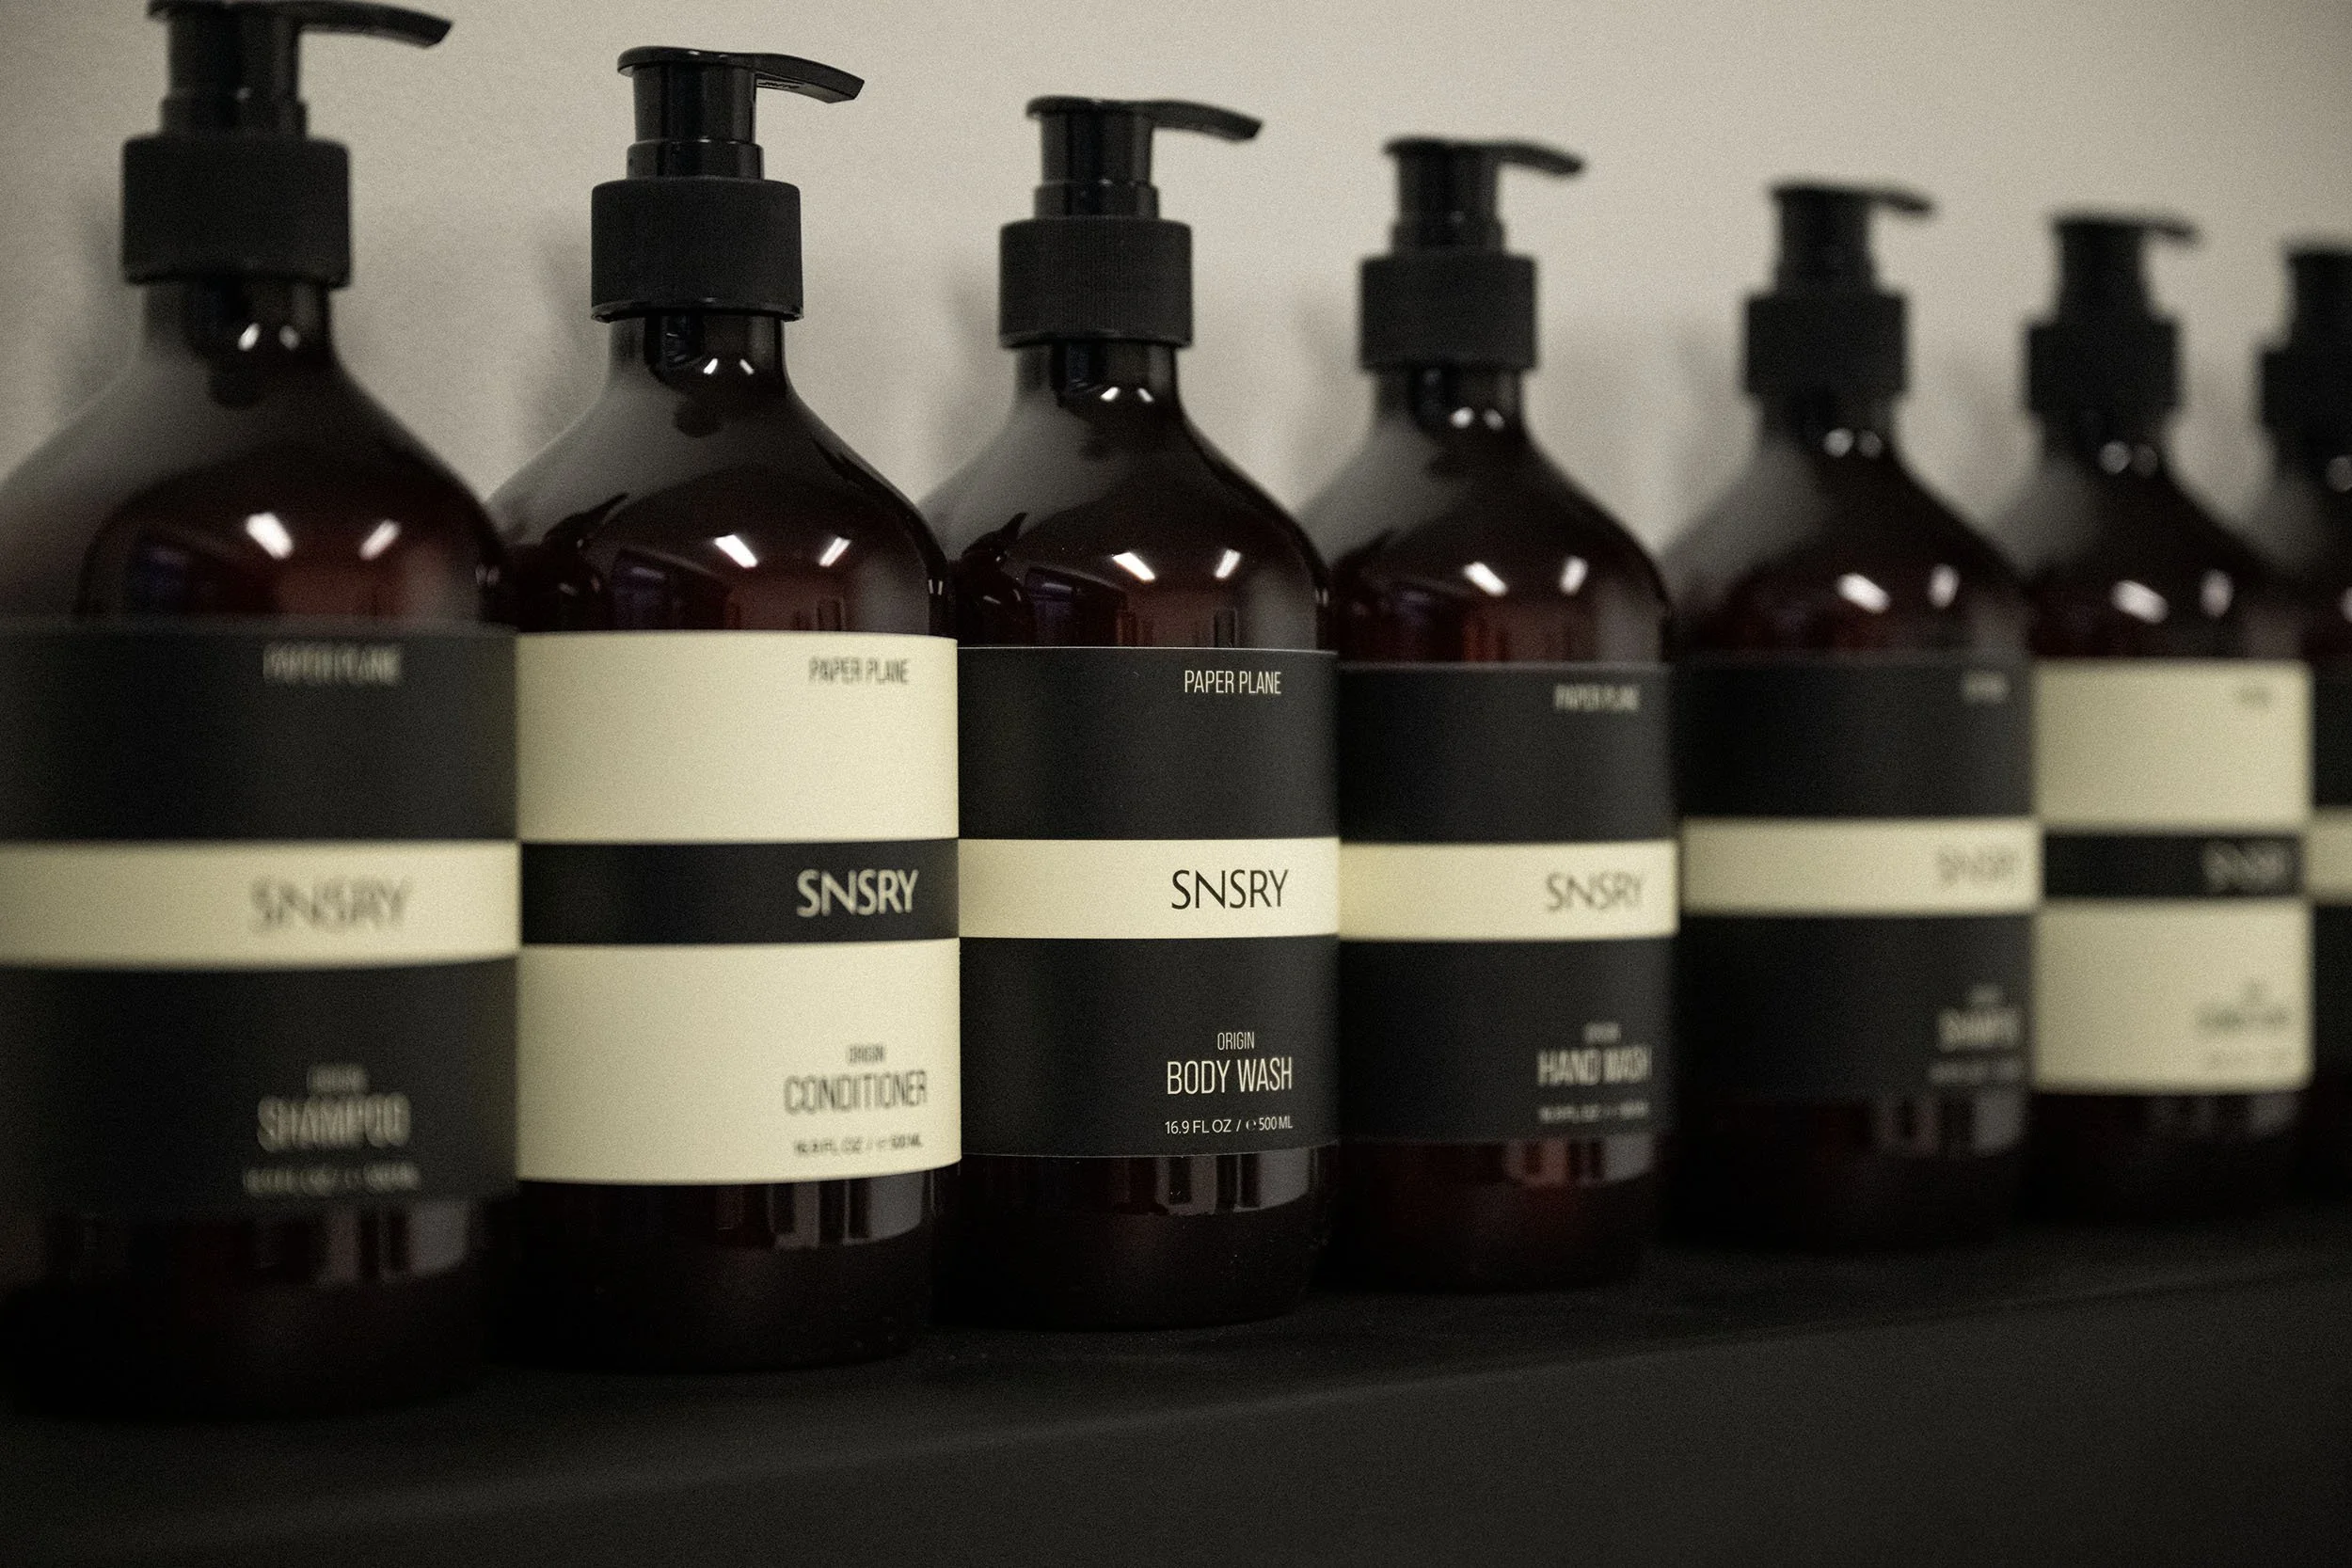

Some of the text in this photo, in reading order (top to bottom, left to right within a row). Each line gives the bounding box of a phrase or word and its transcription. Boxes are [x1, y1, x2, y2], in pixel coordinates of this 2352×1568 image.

[808, 657, 910, 685] PAPER PLANE
[1184, 670, 1281, 694] PAPER PLANE
[250, 876, 412, 933] SNSRY
[797, 868, 919, 917] SNSRY
[1171, 869, 1289, 910] SNSRY
[1546, 870, 1643, 912] SNSRY
[1217, 1031, 1255, 1051] ORIGIN
[1167, 1056, 1293, 1095] BODY WASH
[1537, 1049, 1599, 1086] HAND
[784, 1069, 928, 1115] CONDITIONER
[1165, 1119, 1190, 1135] 16.9
[1193, 1119, 1210, 1134] FL
[1212, 1118, 1232, 1133] OZ
[1258, 1116, 1278, 1132] 500
[1279, 1115, 1294, 1130] ML
